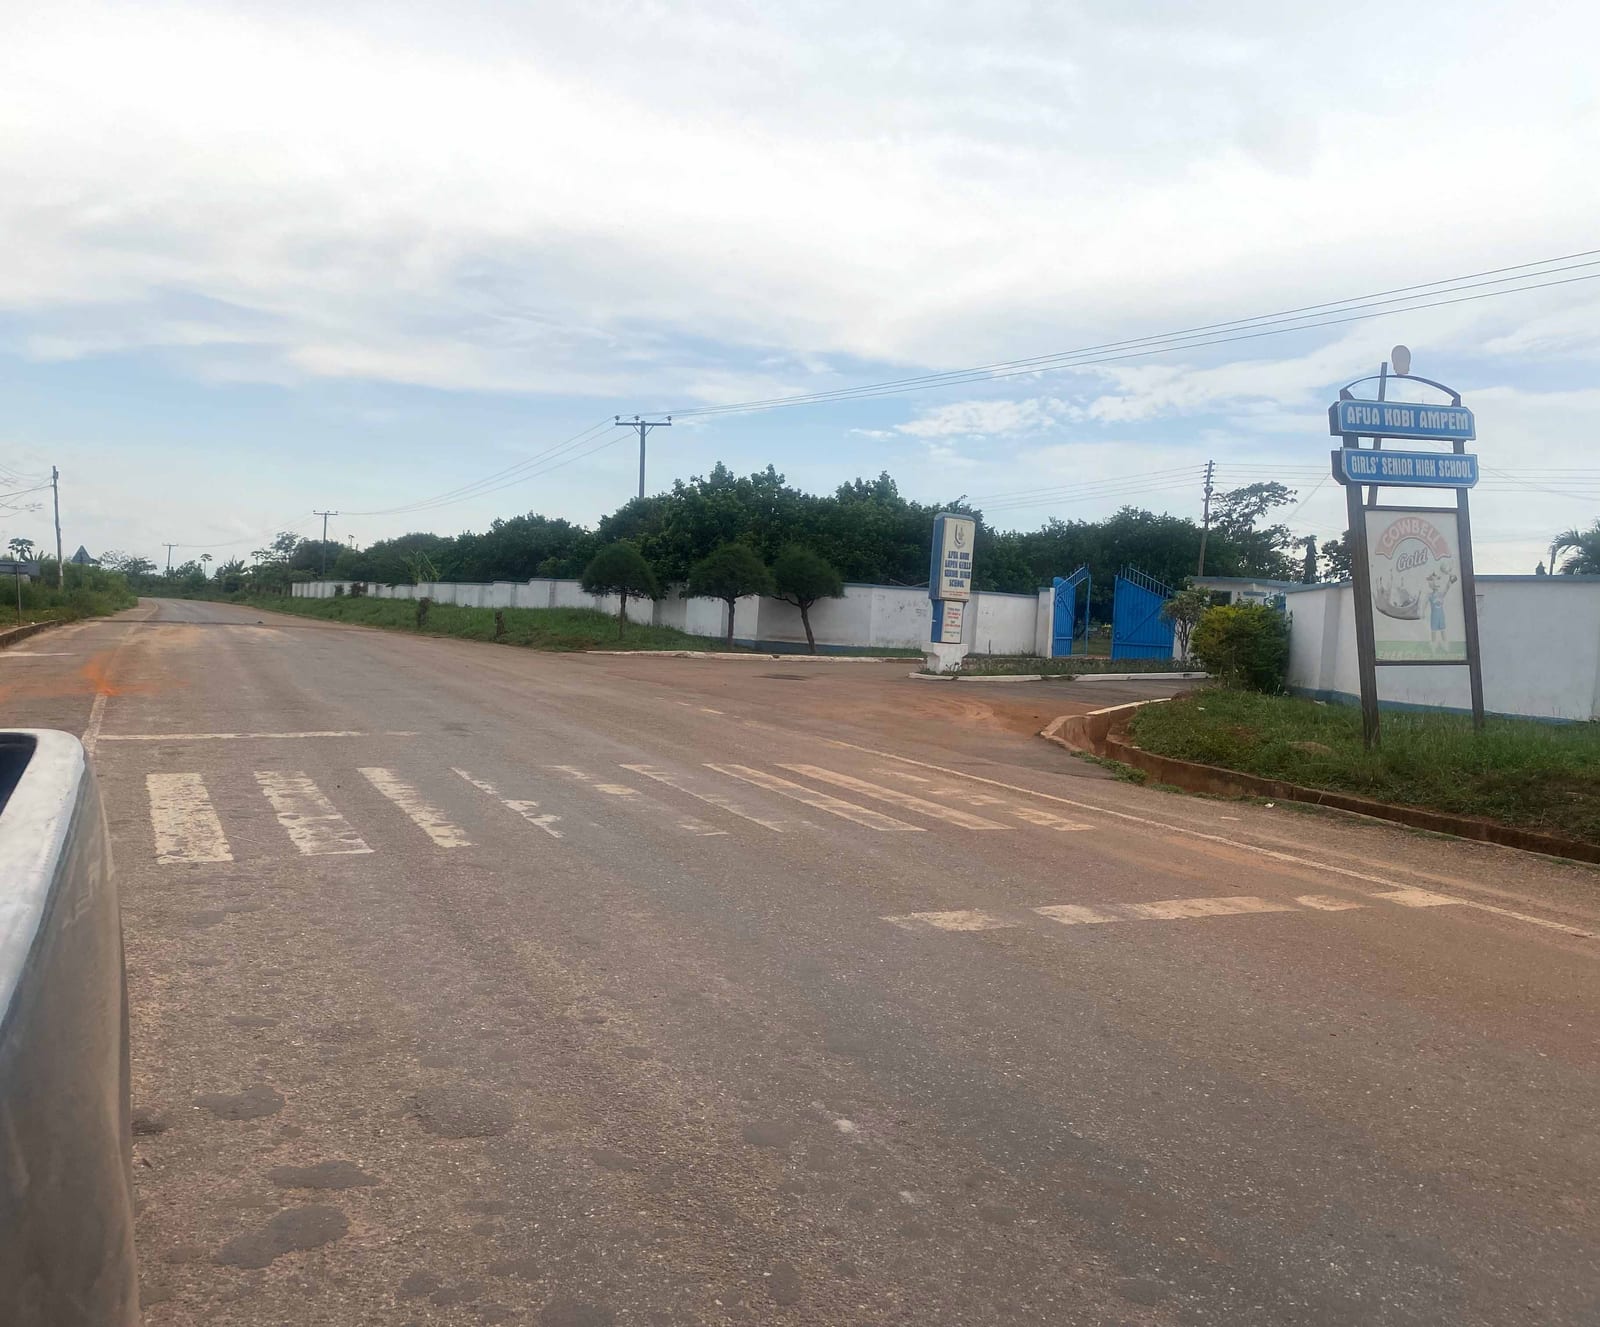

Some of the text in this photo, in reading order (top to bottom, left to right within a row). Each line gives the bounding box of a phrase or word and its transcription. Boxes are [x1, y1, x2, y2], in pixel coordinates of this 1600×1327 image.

[1347, 406, 1469, 430] AFUA KOBI AMPEM
[1351, 455, 1473, 478] GIRLS' SENIOR HIGH SCHOOL
[1382, 519, 1441, 548] COWBELL
[1397, 548, 1428, 572] Gold
